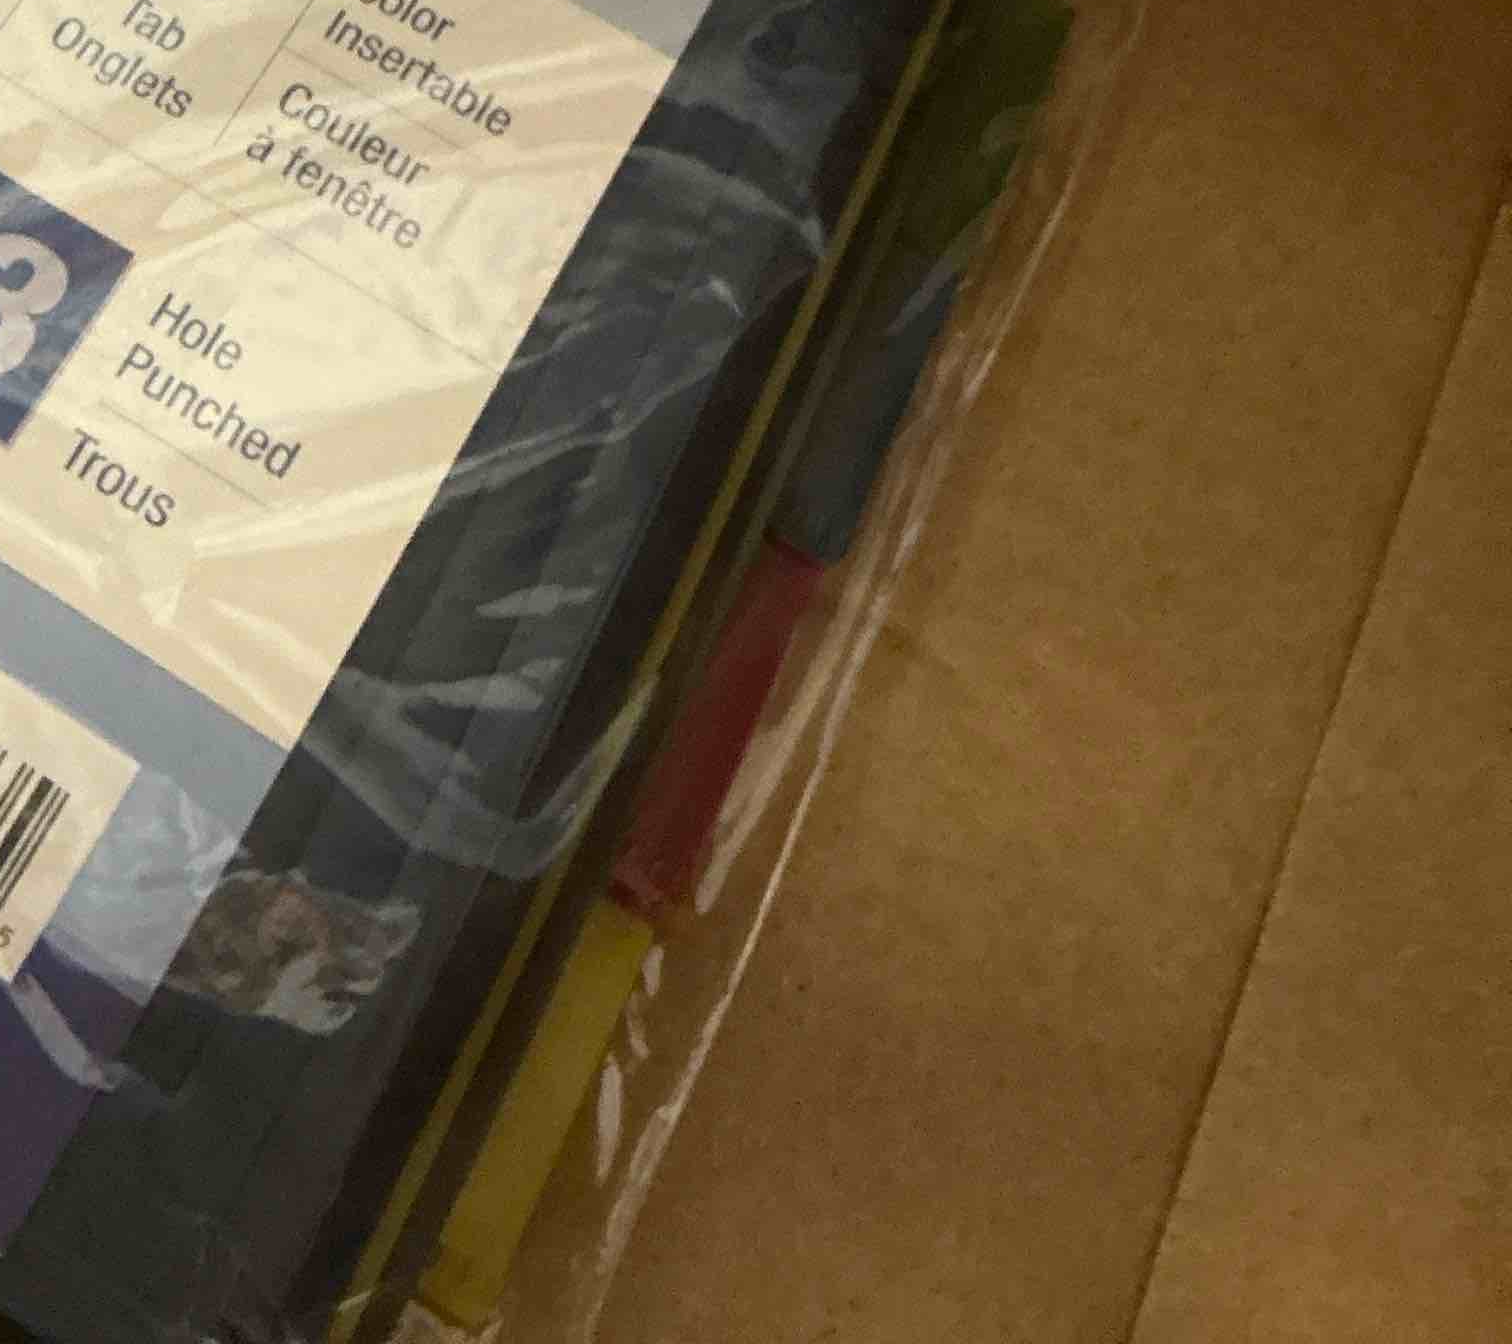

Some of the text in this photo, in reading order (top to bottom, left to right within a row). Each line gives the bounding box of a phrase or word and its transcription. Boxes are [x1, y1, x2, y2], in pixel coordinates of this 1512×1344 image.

[51, 16, 193, 118] Onglets
[323, 9, 514, 138] Insertable
[278, 81, 431, 187] Couleur
[246, 127, 422, 252] à fenêtre
[148, 290, 244, 373] Hole
[115, 343, 304, 481] Punched
[63, 428, 178, 529] Trous
